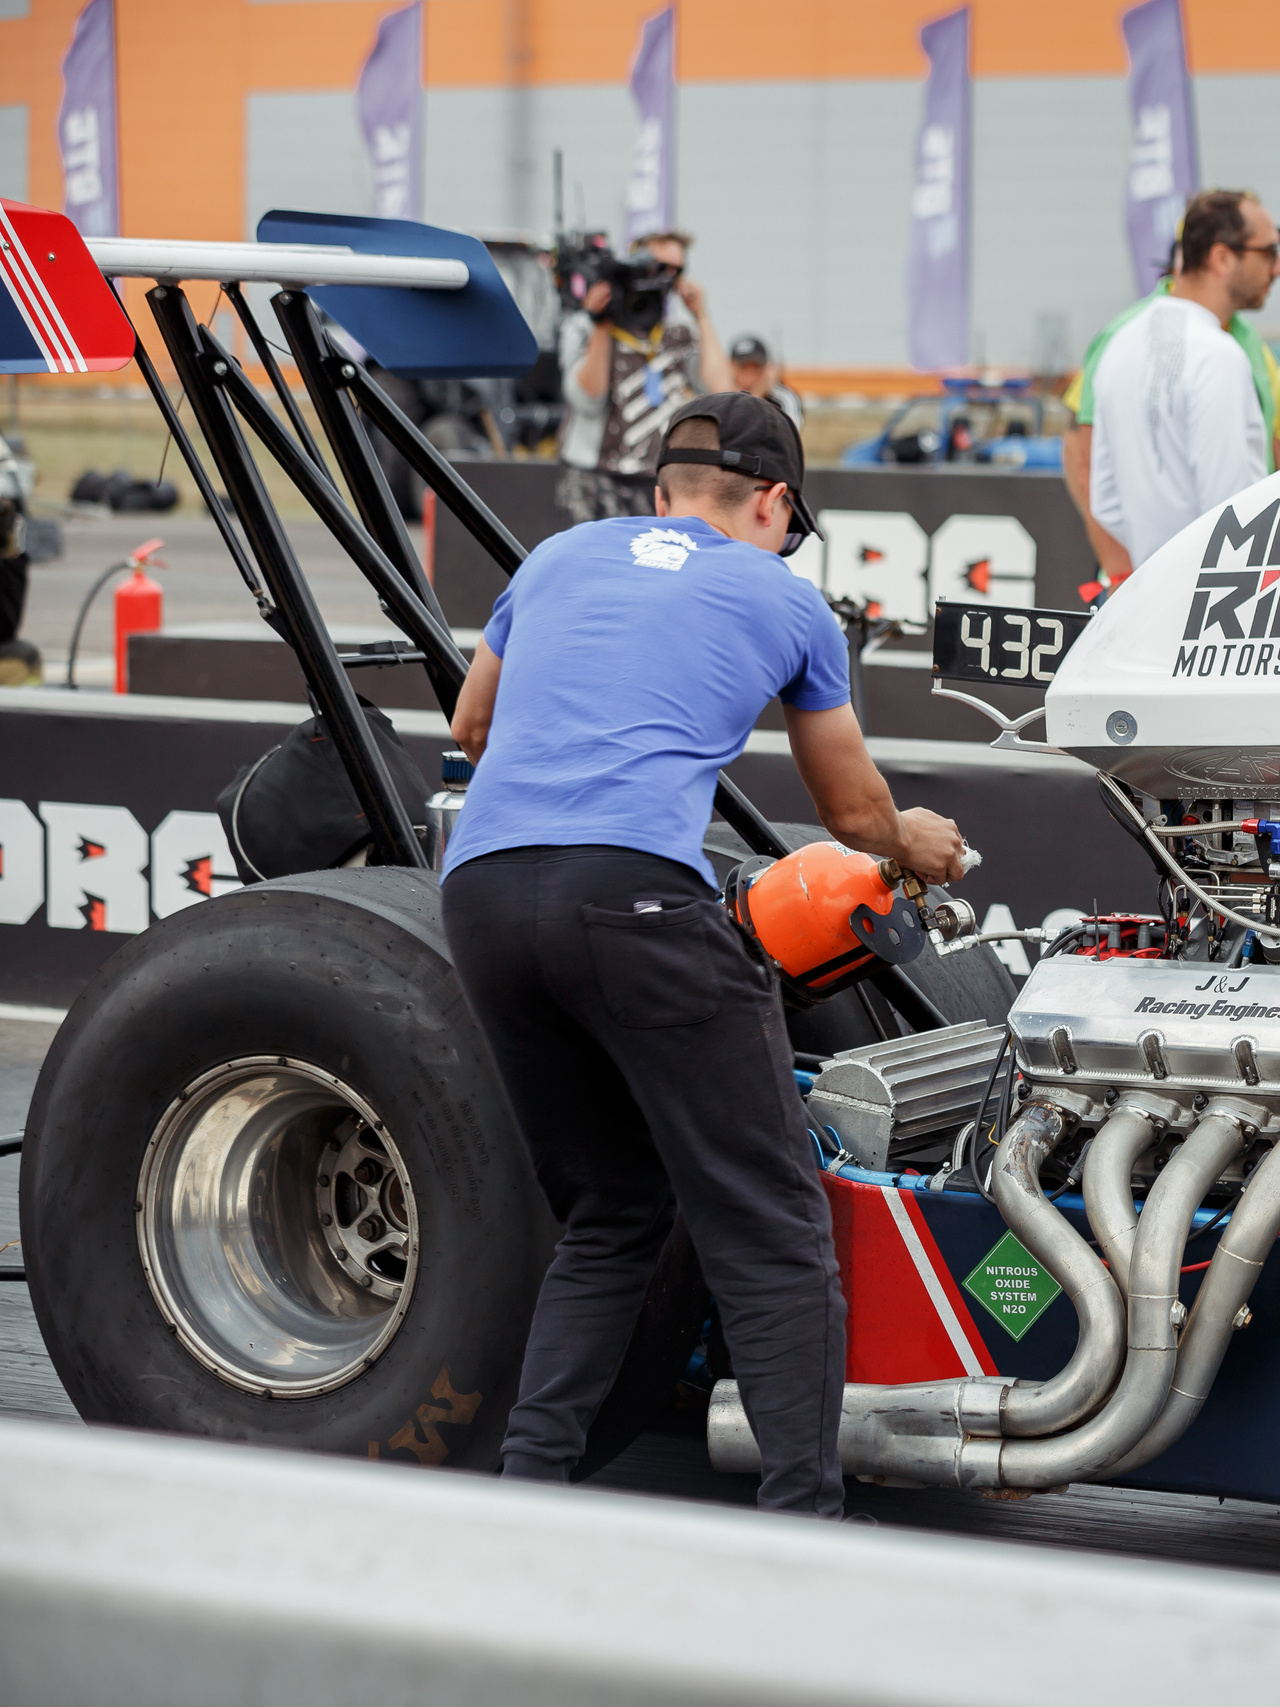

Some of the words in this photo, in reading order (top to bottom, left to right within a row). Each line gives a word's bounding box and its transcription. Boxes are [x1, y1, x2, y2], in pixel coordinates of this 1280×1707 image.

[961, 611, 1065, 681] 4.32
[1134, 996, 1211, 1020] Racing
[986, 1266, 1038, 1276] NITROUS
[995, 1279, 1030, 1289] OXIDE
[990, 1291, 1037, 1302] SYSTEM
[1002, 1304, 1026, 1314] N2O
